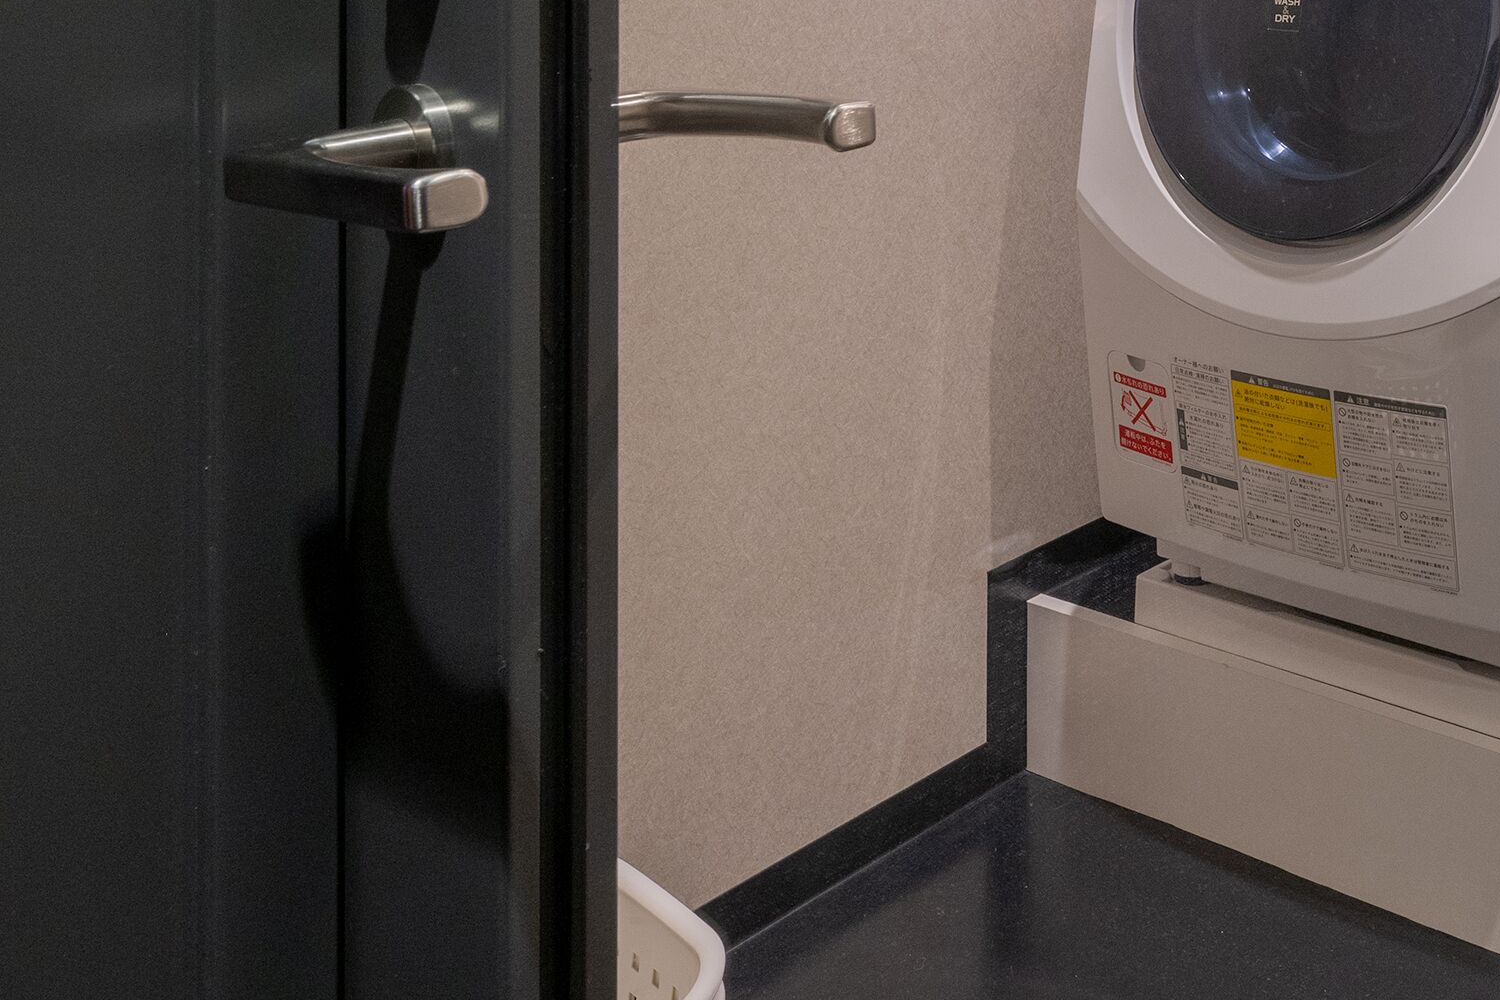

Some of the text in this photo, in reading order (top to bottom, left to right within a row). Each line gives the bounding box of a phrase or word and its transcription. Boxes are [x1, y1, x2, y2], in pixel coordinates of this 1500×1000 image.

[1274, 14, 1296, 23] DRY
[1282, 5, 1290, 15] &
[1121, 376, 1164, 396] 水もれの恐れあり
[1121, 437, 1172, 461] 開けないでください。
[1124, 430, 1166, 450] 運転中は、ふたを
